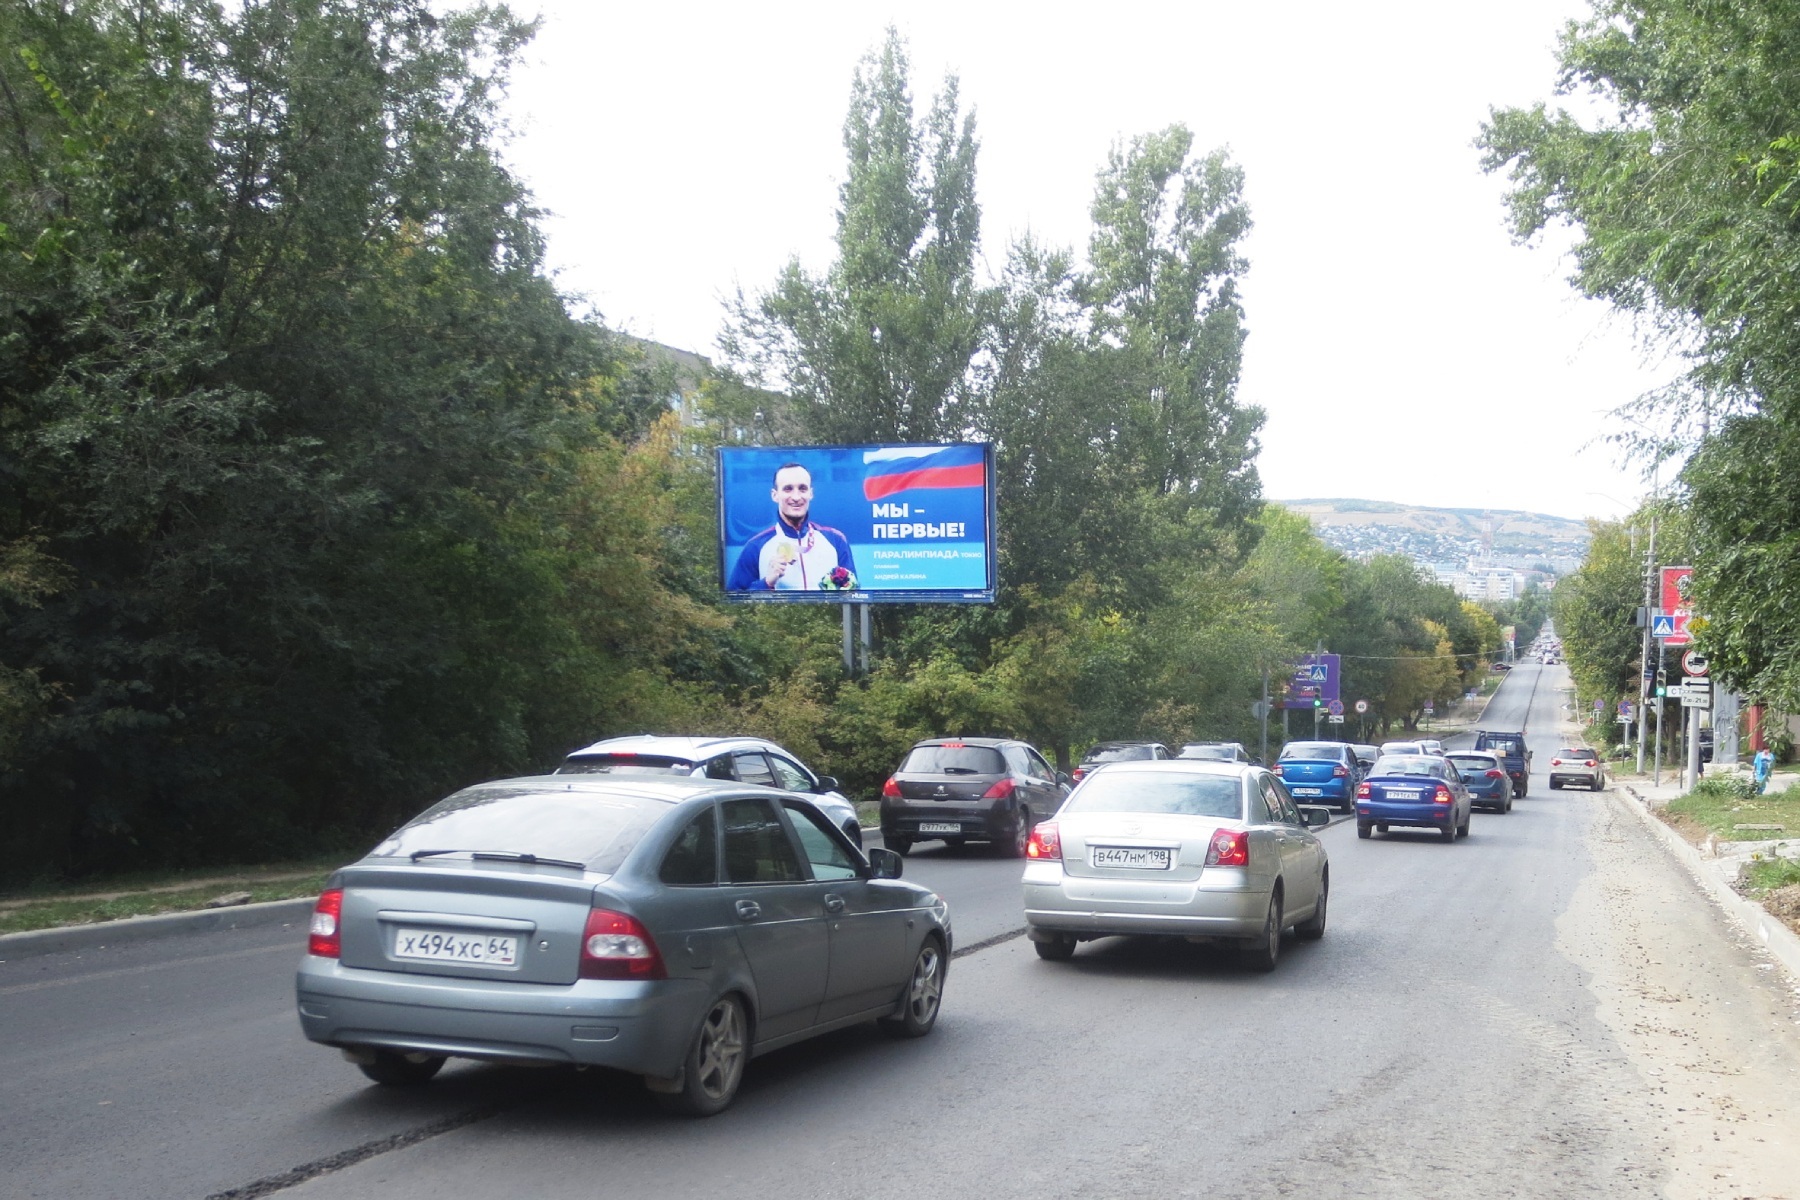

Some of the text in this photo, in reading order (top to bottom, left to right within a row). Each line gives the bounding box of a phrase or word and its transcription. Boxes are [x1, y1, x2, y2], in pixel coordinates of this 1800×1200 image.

[872, 503, 909, 518] МЫ
[872, 522, 965, 539] ПЕРВЫЕ!
[873, 549, 959, 559] ПАРАЛИМПИАДА
